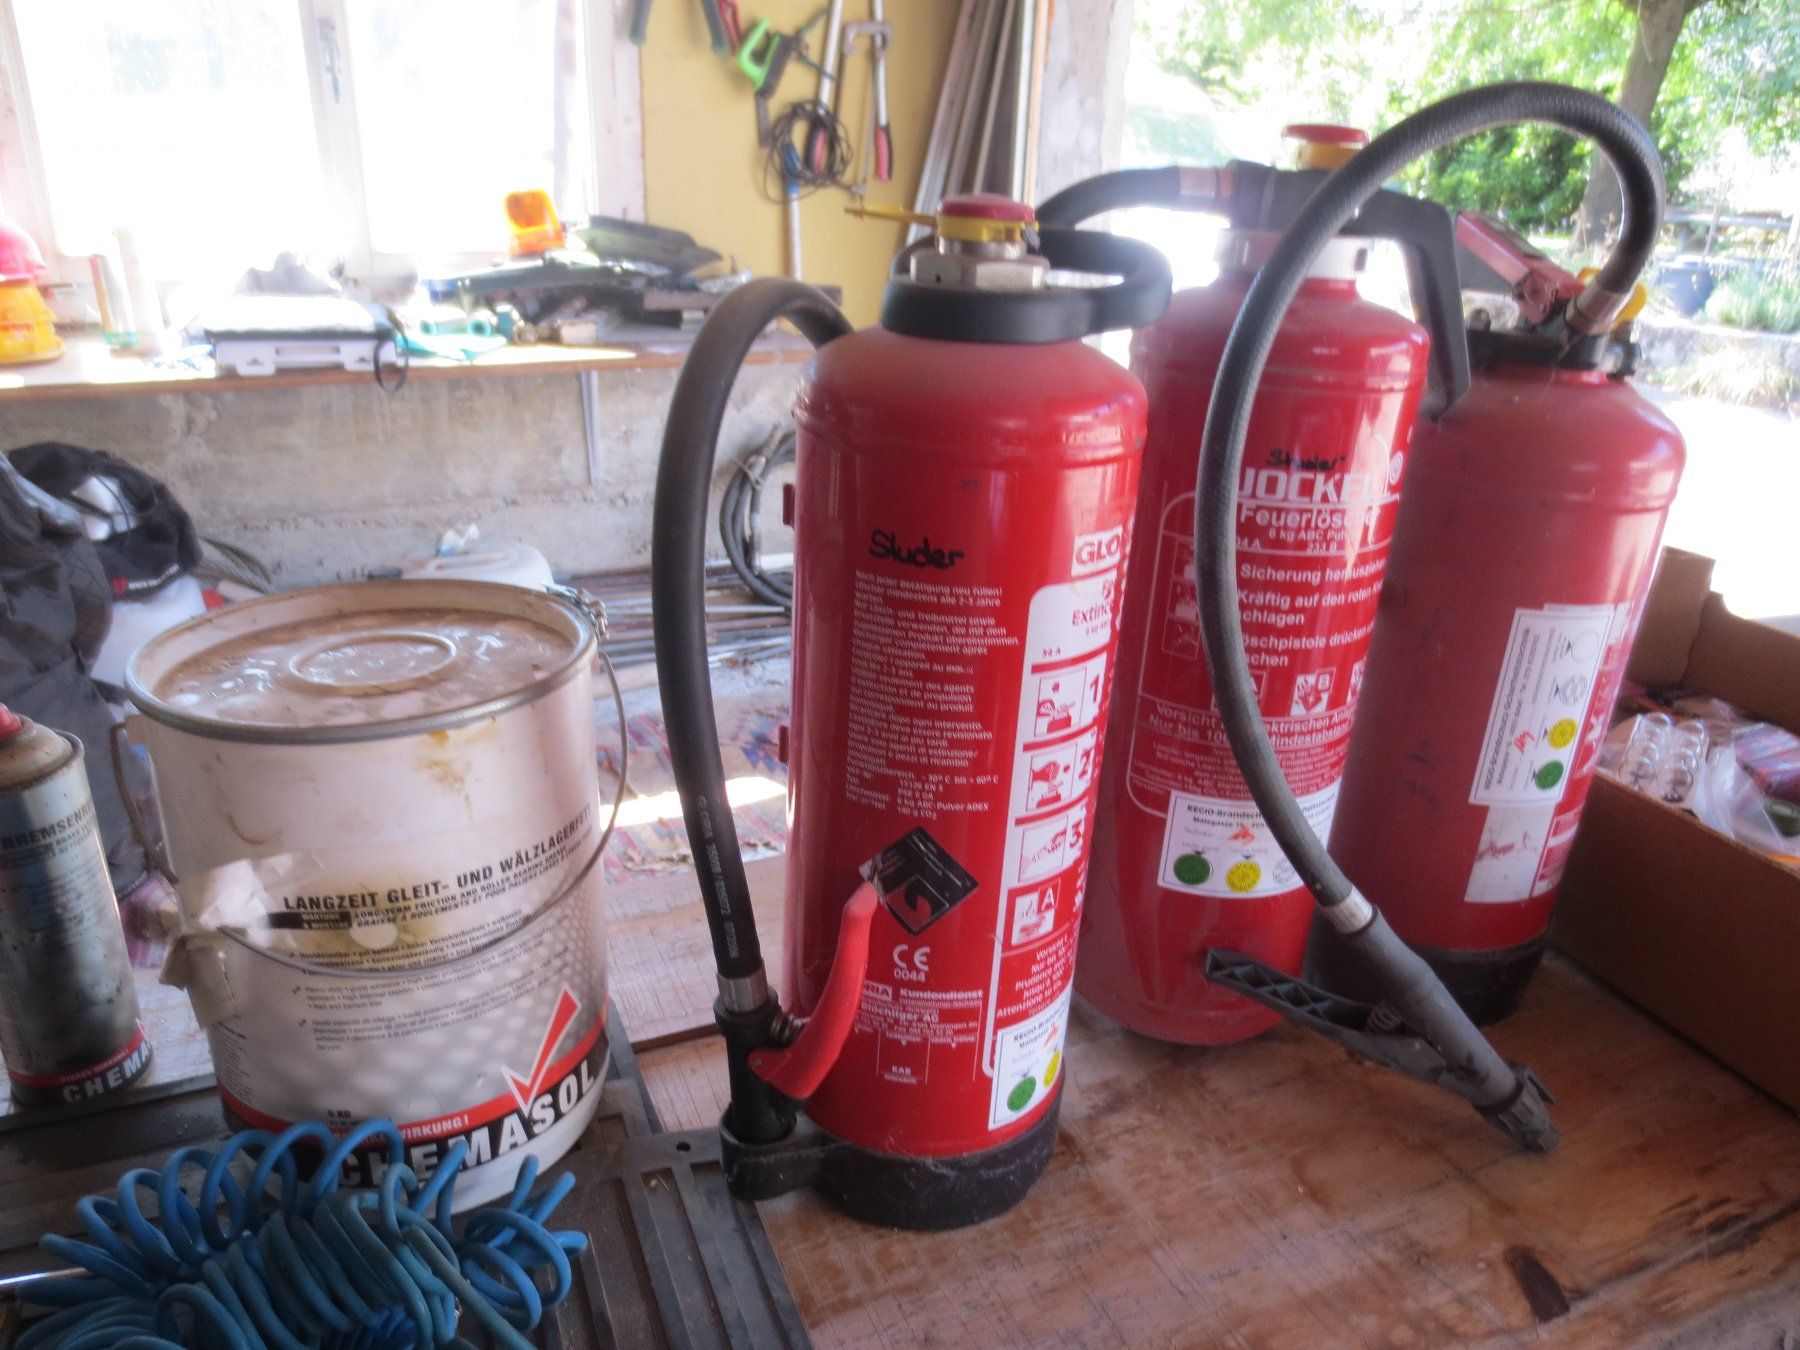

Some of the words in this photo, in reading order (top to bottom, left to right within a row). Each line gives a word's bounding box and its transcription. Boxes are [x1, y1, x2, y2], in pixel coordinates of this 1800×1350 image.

[1241, 562, 1322, 586] Sicherung
[1238, 587, 1291, 610] Kräftig
[1295, 592, 1319, 608] auf
[1322, 592, 1345, 607] den
[1241, 609, 1304, 629] chlagen
[1241, 630, 1327, 651] öschpistole
[1262, 716, 1330, 735] ektrischen
[283, 891, 379, 911] LANGZEIT
[456, 865, 493, 888] UND
[415, 895, 457, 911] FRICTION
[460, 888, 478, 899] AND
